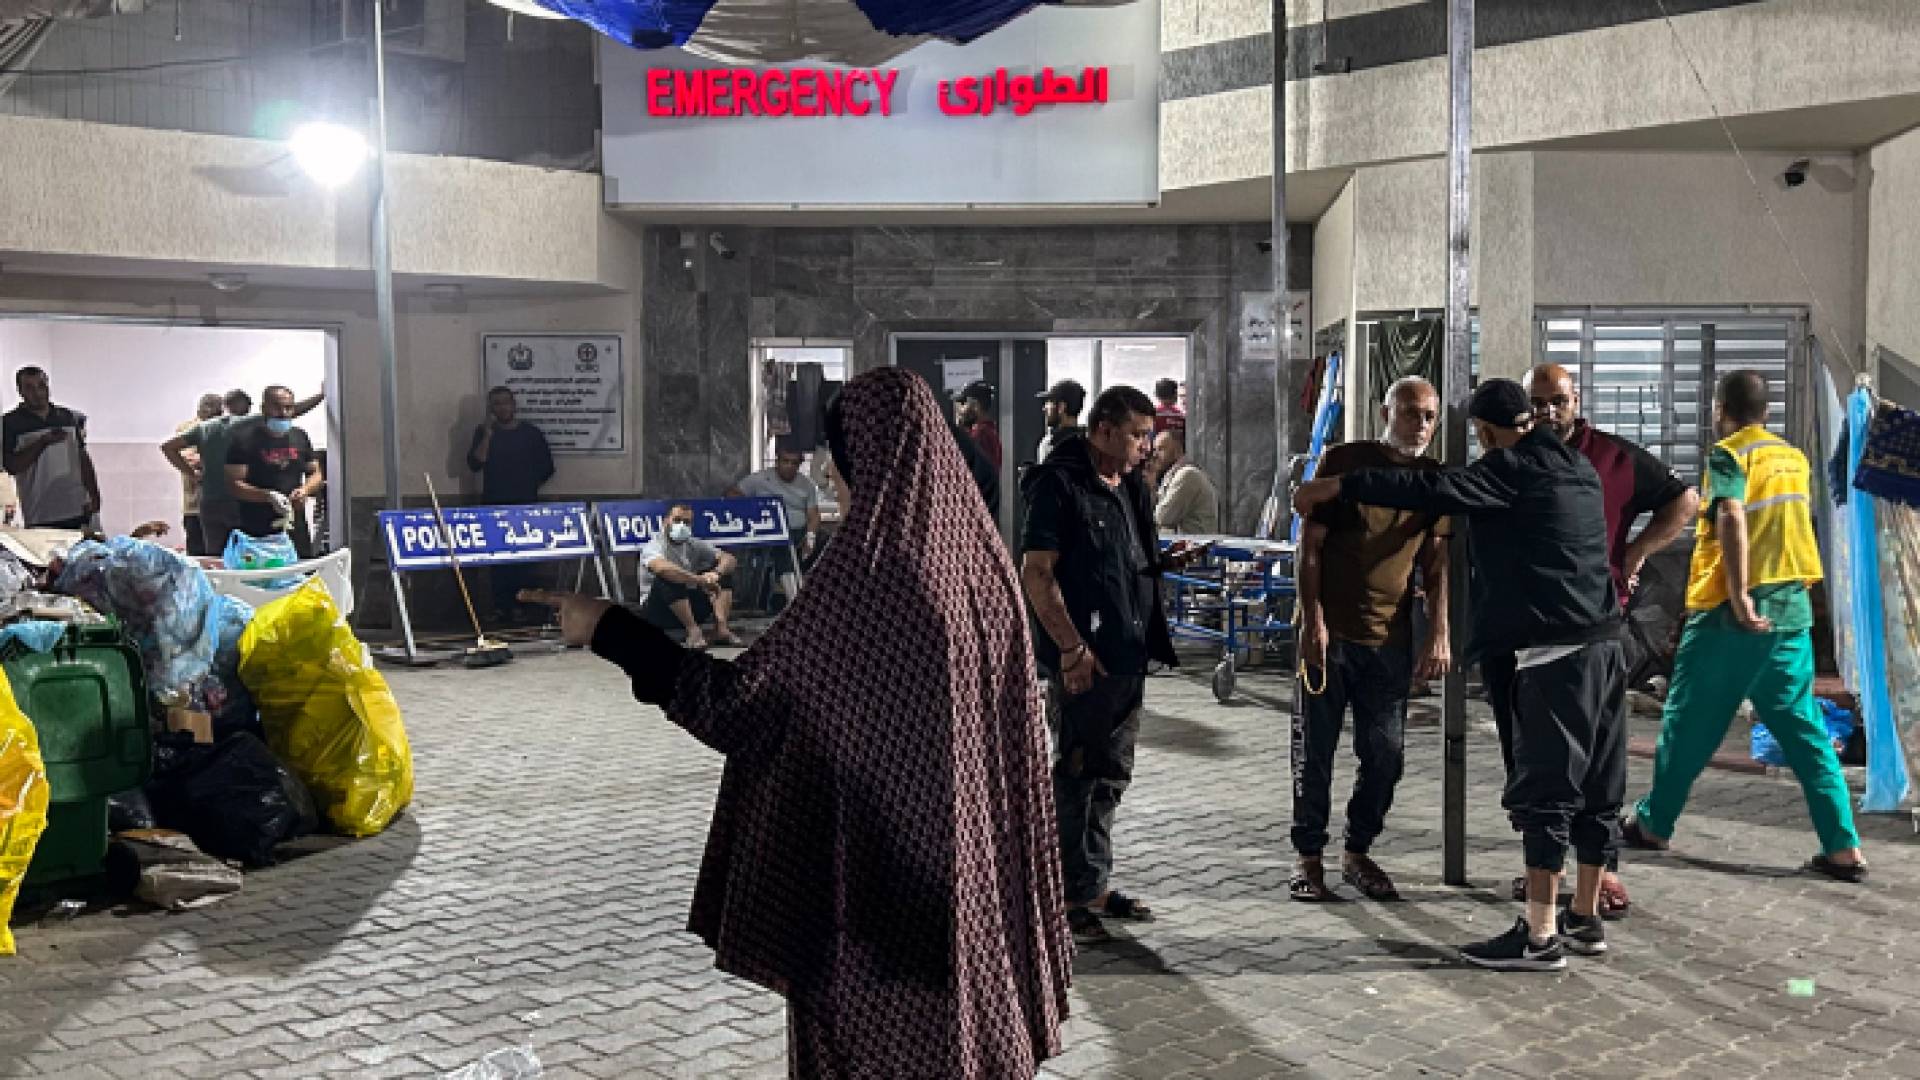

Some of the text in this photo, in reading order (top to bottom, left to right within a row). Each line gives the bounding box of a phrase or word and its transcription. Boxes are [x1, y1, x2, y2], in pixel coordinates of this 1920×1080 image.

[647, 68, 899, 118] EMERGENCY
[937, 66, 1108, 117] الطوارئ
[496, 515, 579, 549] شرطة
